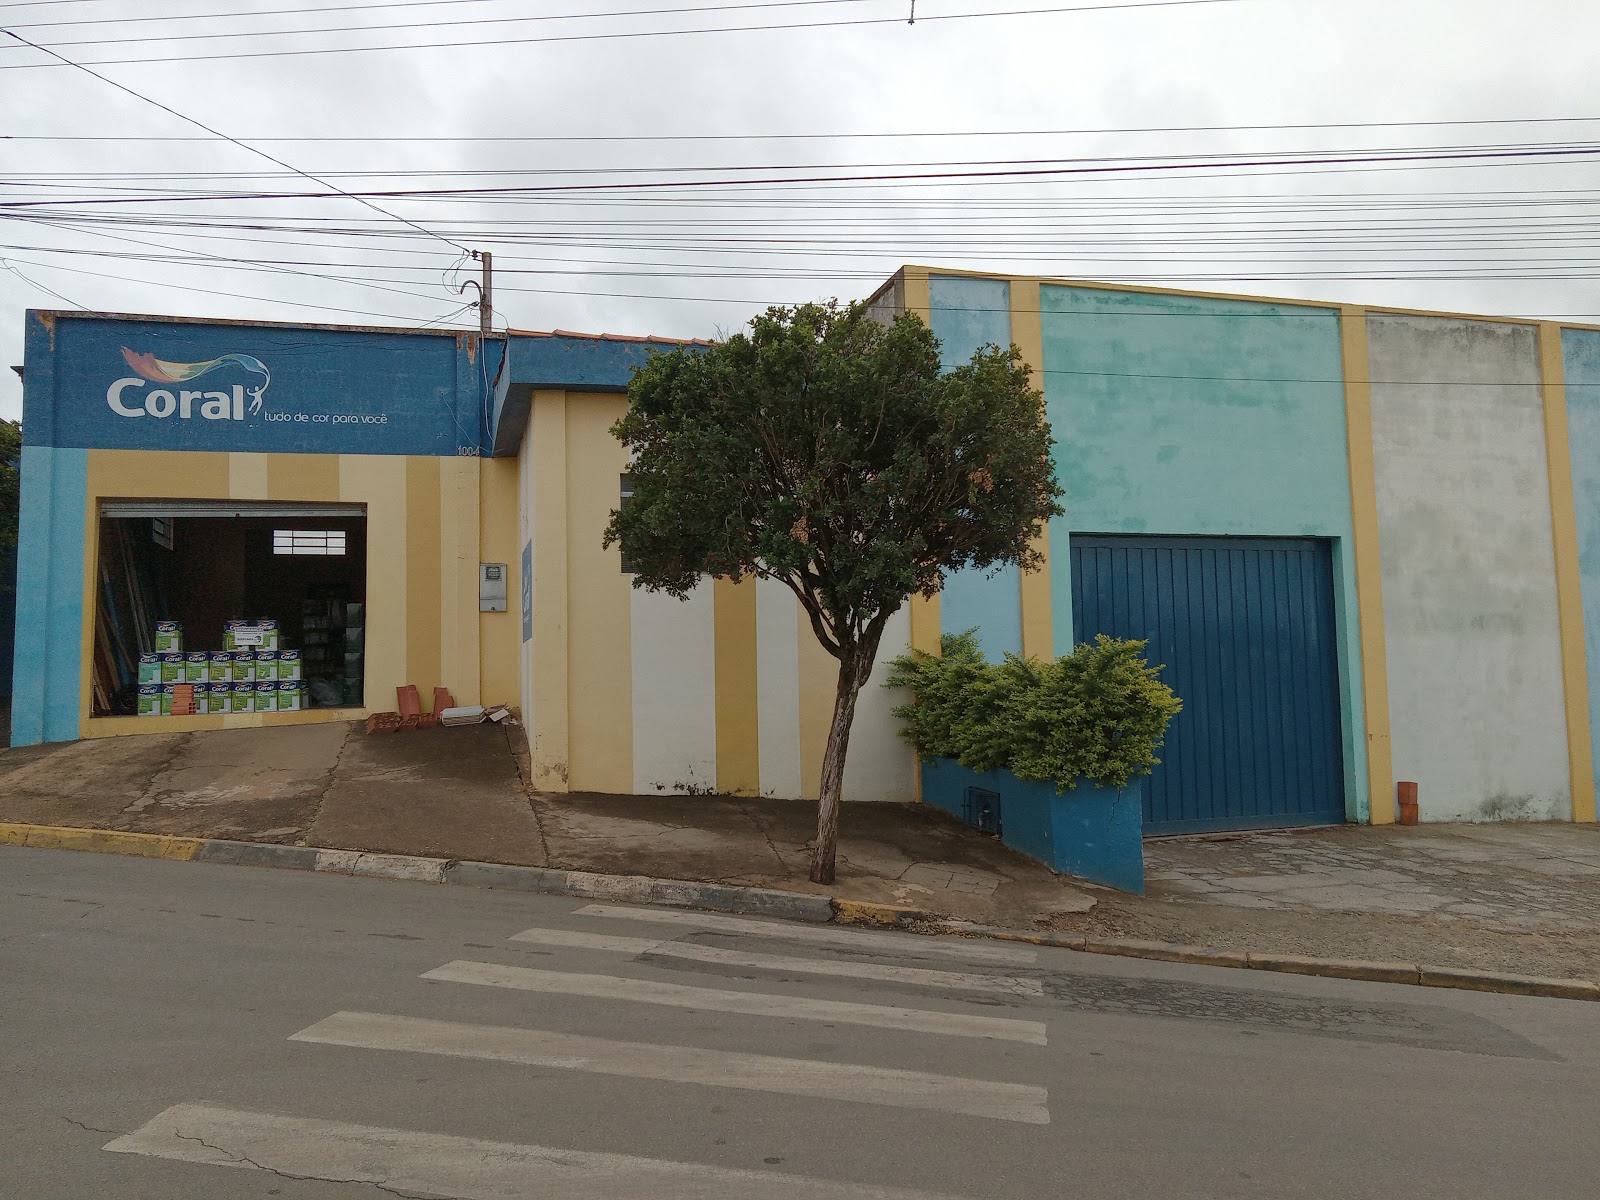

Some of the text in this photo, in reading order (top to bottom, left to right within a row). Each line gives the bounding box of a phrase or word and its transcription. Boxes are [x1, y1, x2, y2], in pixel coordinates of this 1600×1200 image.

[106, 377, 244, 420] Coral
[264, 411, 388, 425] tudo de cor para você
[457, 445, 480, 456] 1004
